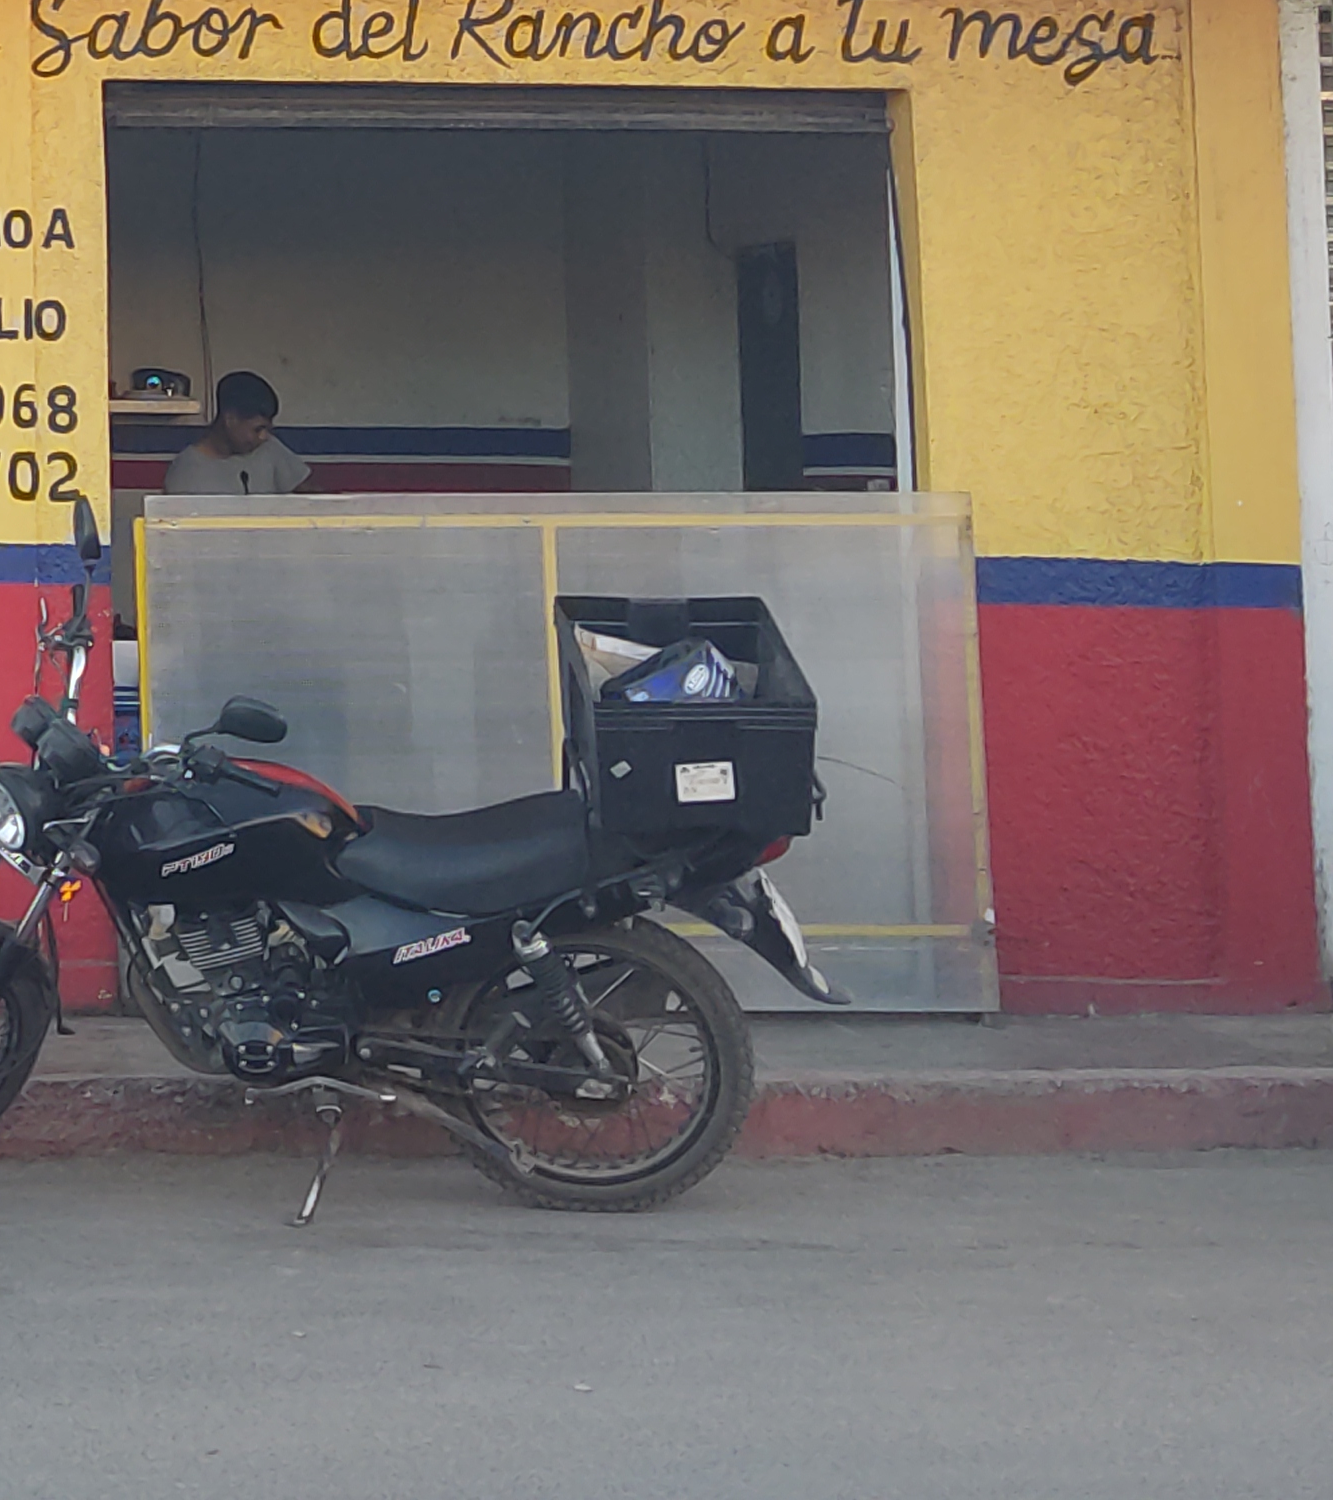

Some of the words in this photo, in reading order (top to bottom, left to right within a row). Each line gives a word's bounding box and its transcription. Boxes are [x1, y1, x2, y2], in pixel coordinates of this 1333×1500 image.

[765, 14, 814, 61] a
[941, 5, 1160, 85] mesa
[42, 208, 76, 250] A
